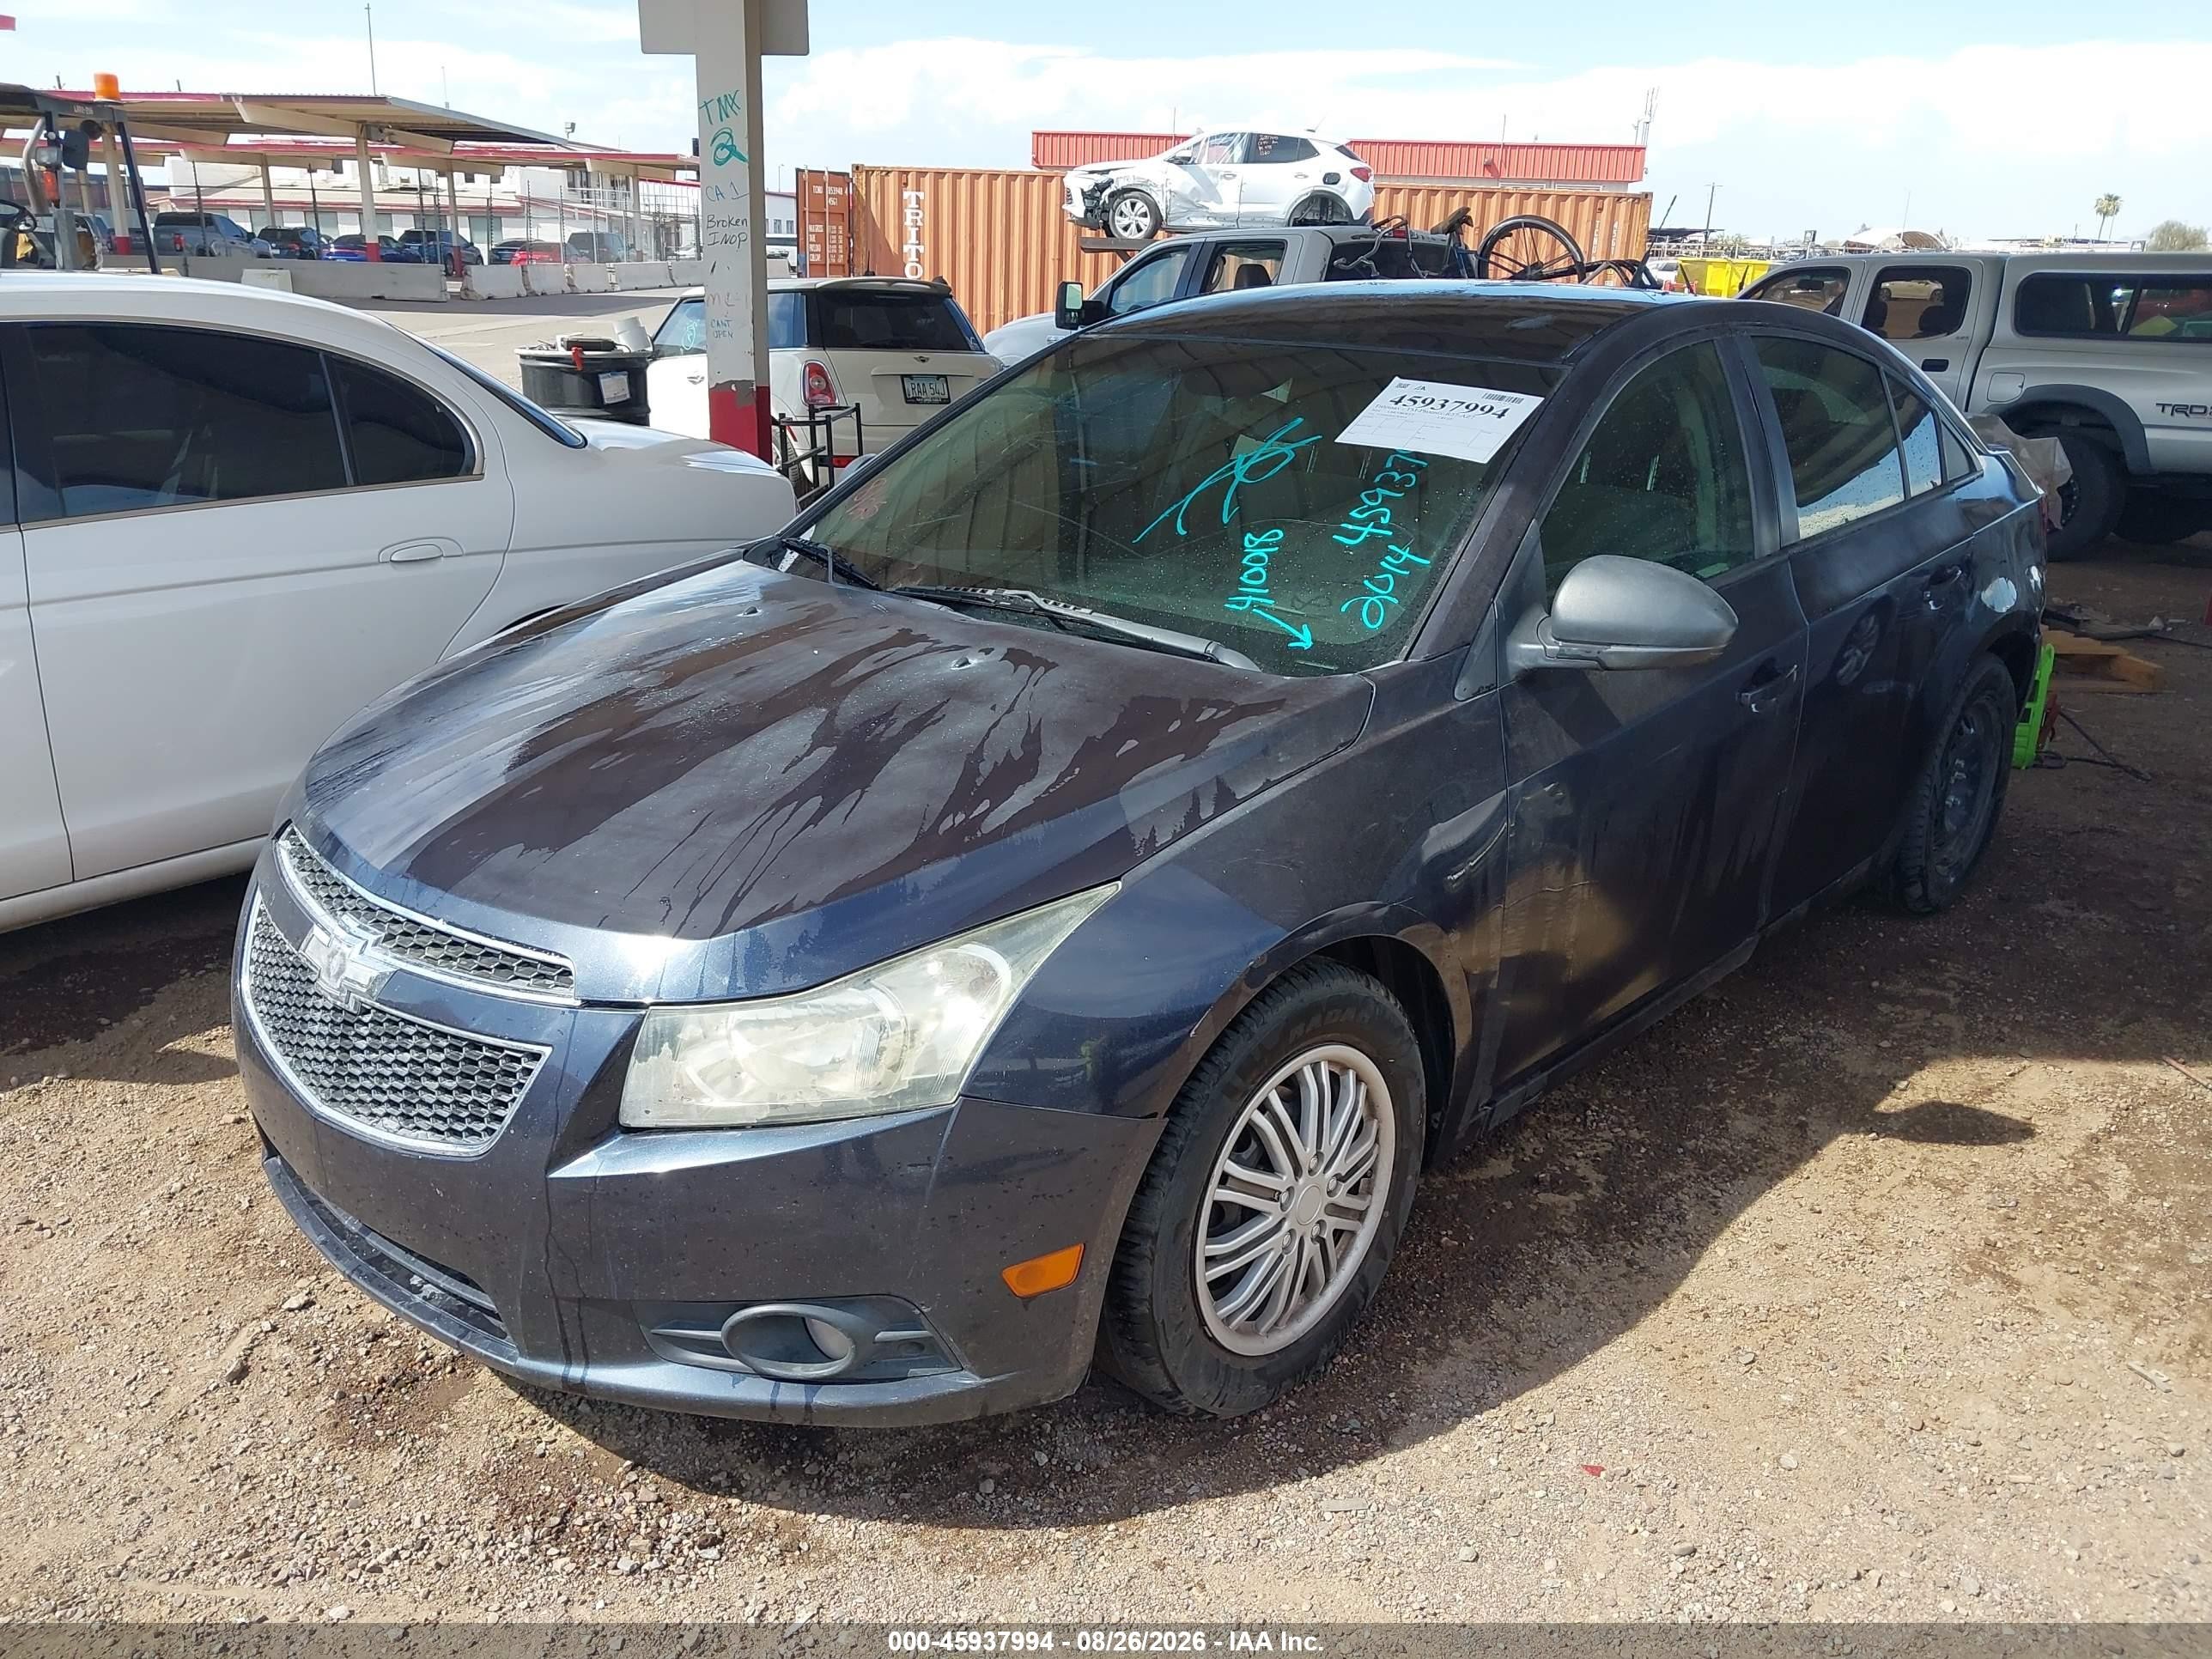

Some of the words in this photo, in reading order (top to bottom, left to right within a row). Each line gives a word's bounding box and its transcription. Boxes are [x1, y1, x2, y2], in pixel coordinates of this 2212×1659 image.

[699, 89, 741, 125] TMX
[707, 215, 748, 229] Broken
[708, 232, 748, 248] INOP
[1389, 393, 1510, 419] 45937994
[1333, 449, 1428, 544] 45937
[1340, 544, 1431, 629] 2014
